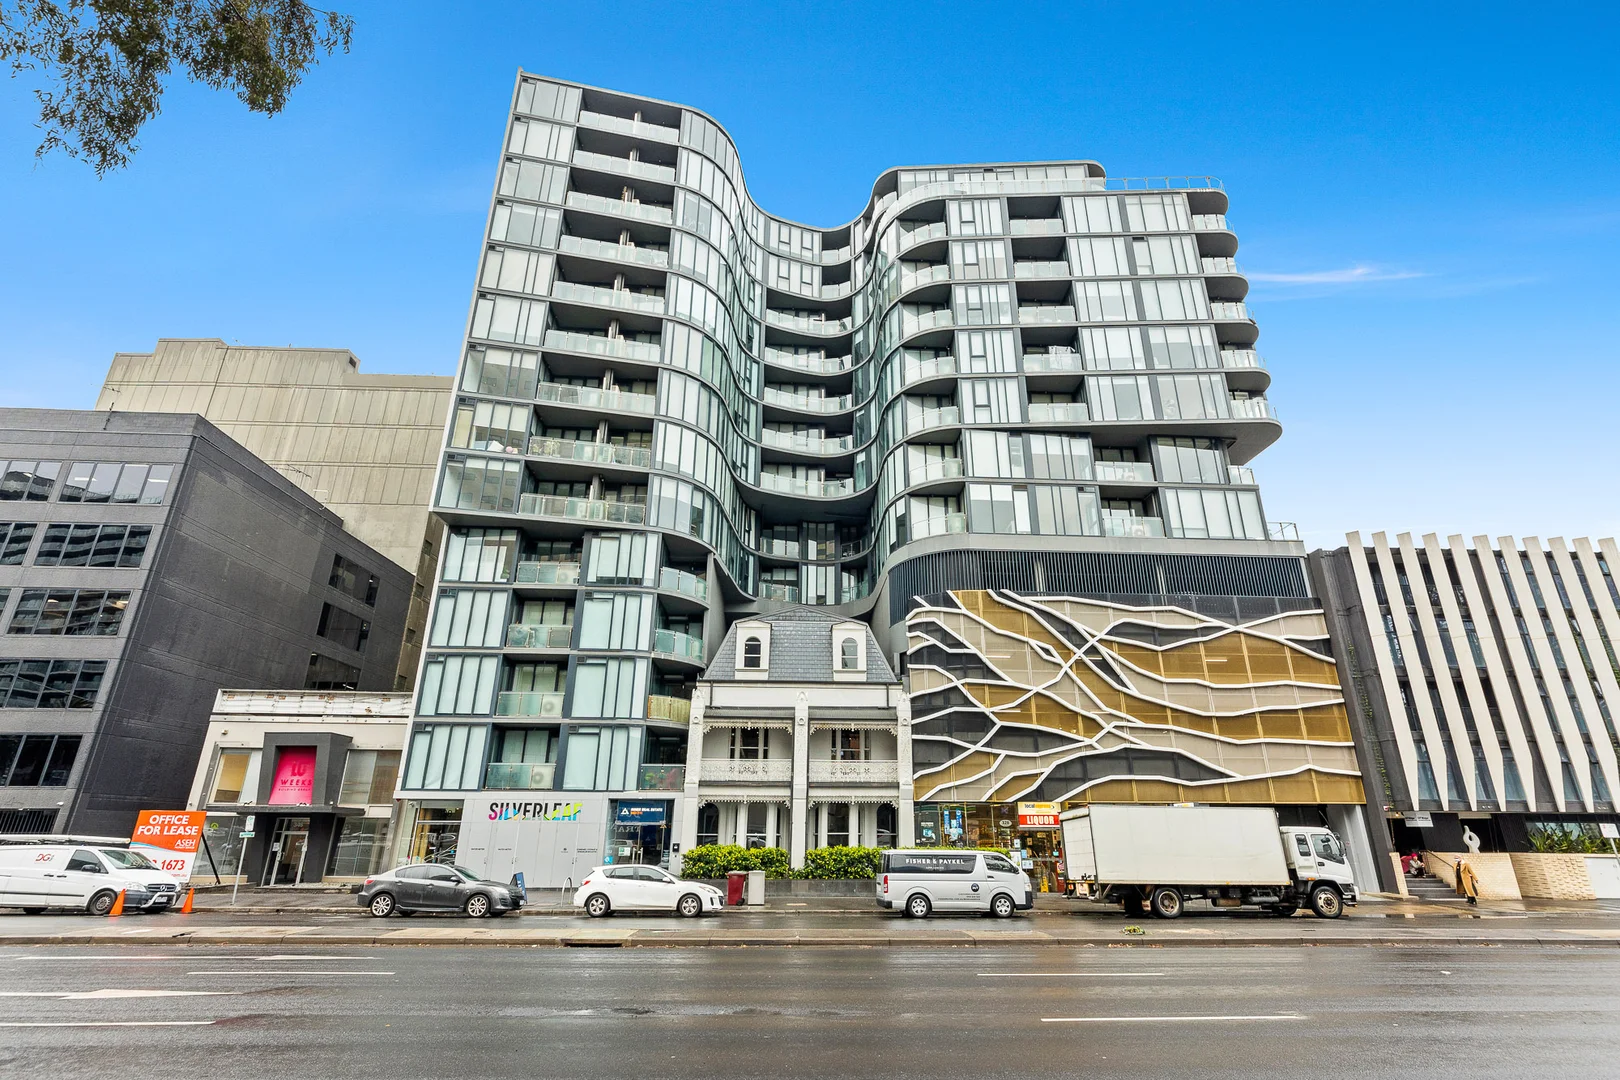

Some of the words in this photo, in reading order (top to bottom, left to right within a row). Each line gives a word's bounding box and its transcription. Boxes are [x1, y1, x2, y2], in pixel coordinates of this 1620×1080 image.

[488, 802, 583, 821] SILVERLEAF
[149, 815, 190, 825] OFFICE
[1026, 815, 1055, 825] LIQUOR
[137, 825, 161, 835] FOR
[163, 825, 199, 836] LEASE
[161, 859, 186, 871] 1673
[939, 858, 965, 866] PAYKEL
